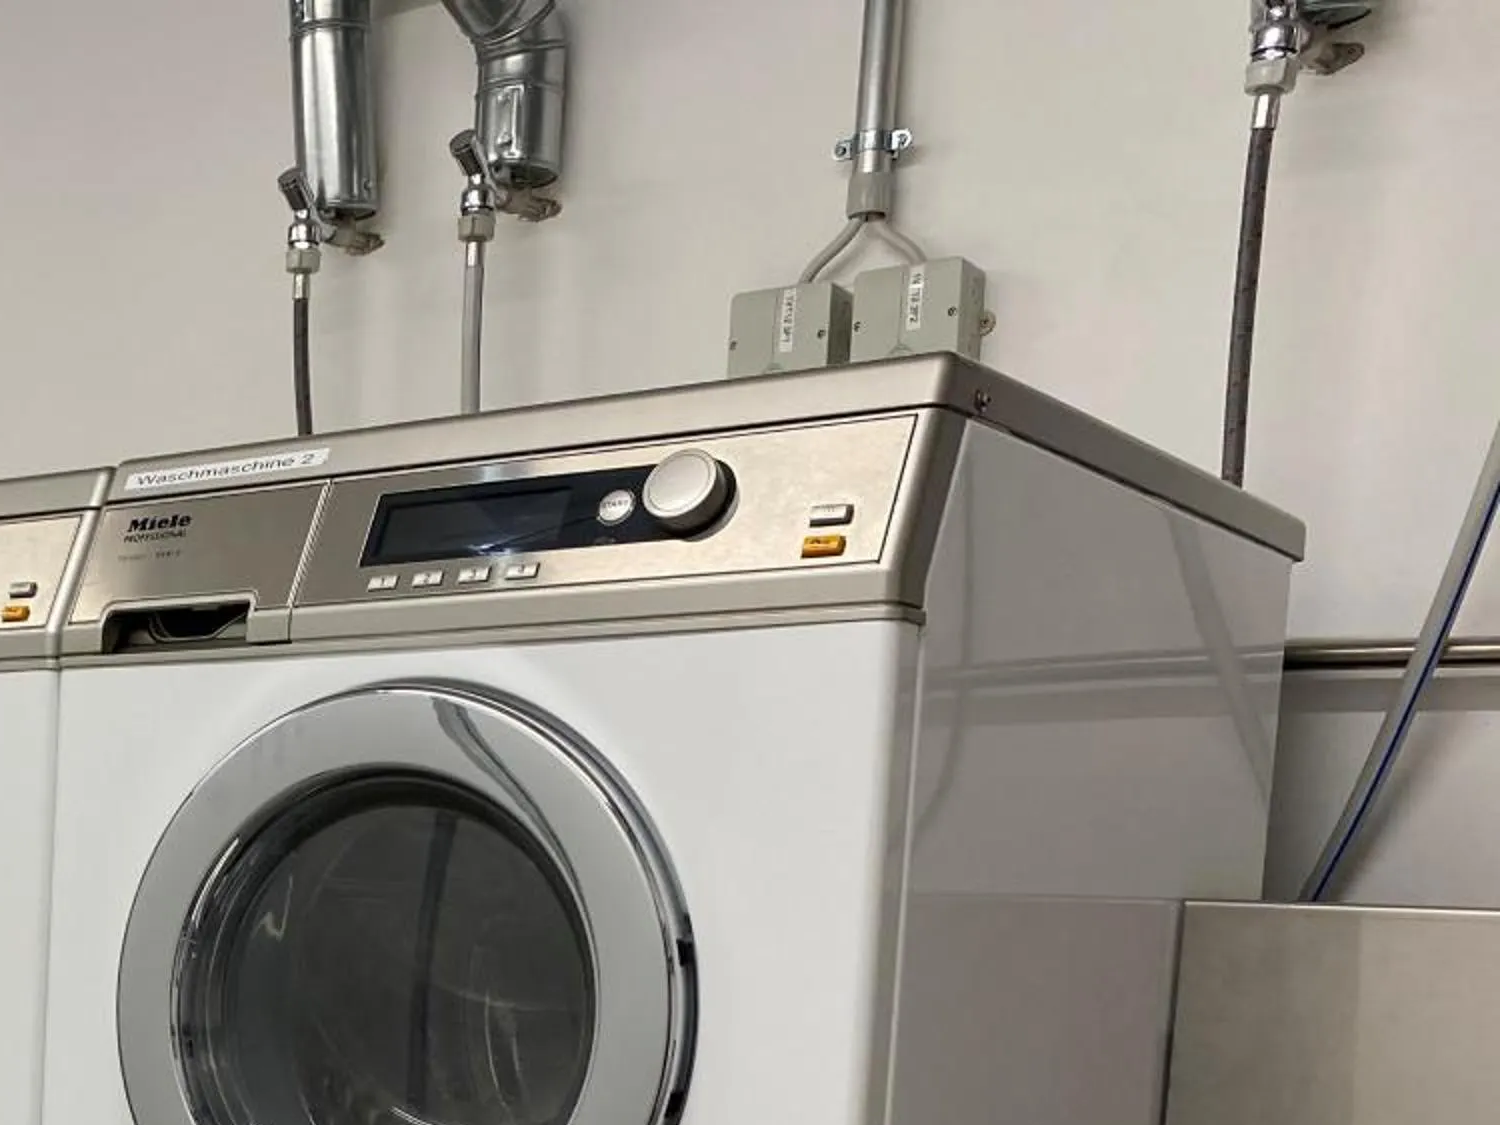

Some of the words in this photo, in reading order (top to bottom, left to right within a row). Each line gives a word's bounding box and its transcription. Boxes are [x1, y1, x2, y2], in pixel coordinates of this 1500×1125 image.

[136, 457, 295, 487] Waschmaschine
[300, 452, 316, 465] 2
[127, 513, 192, 533] Miele
